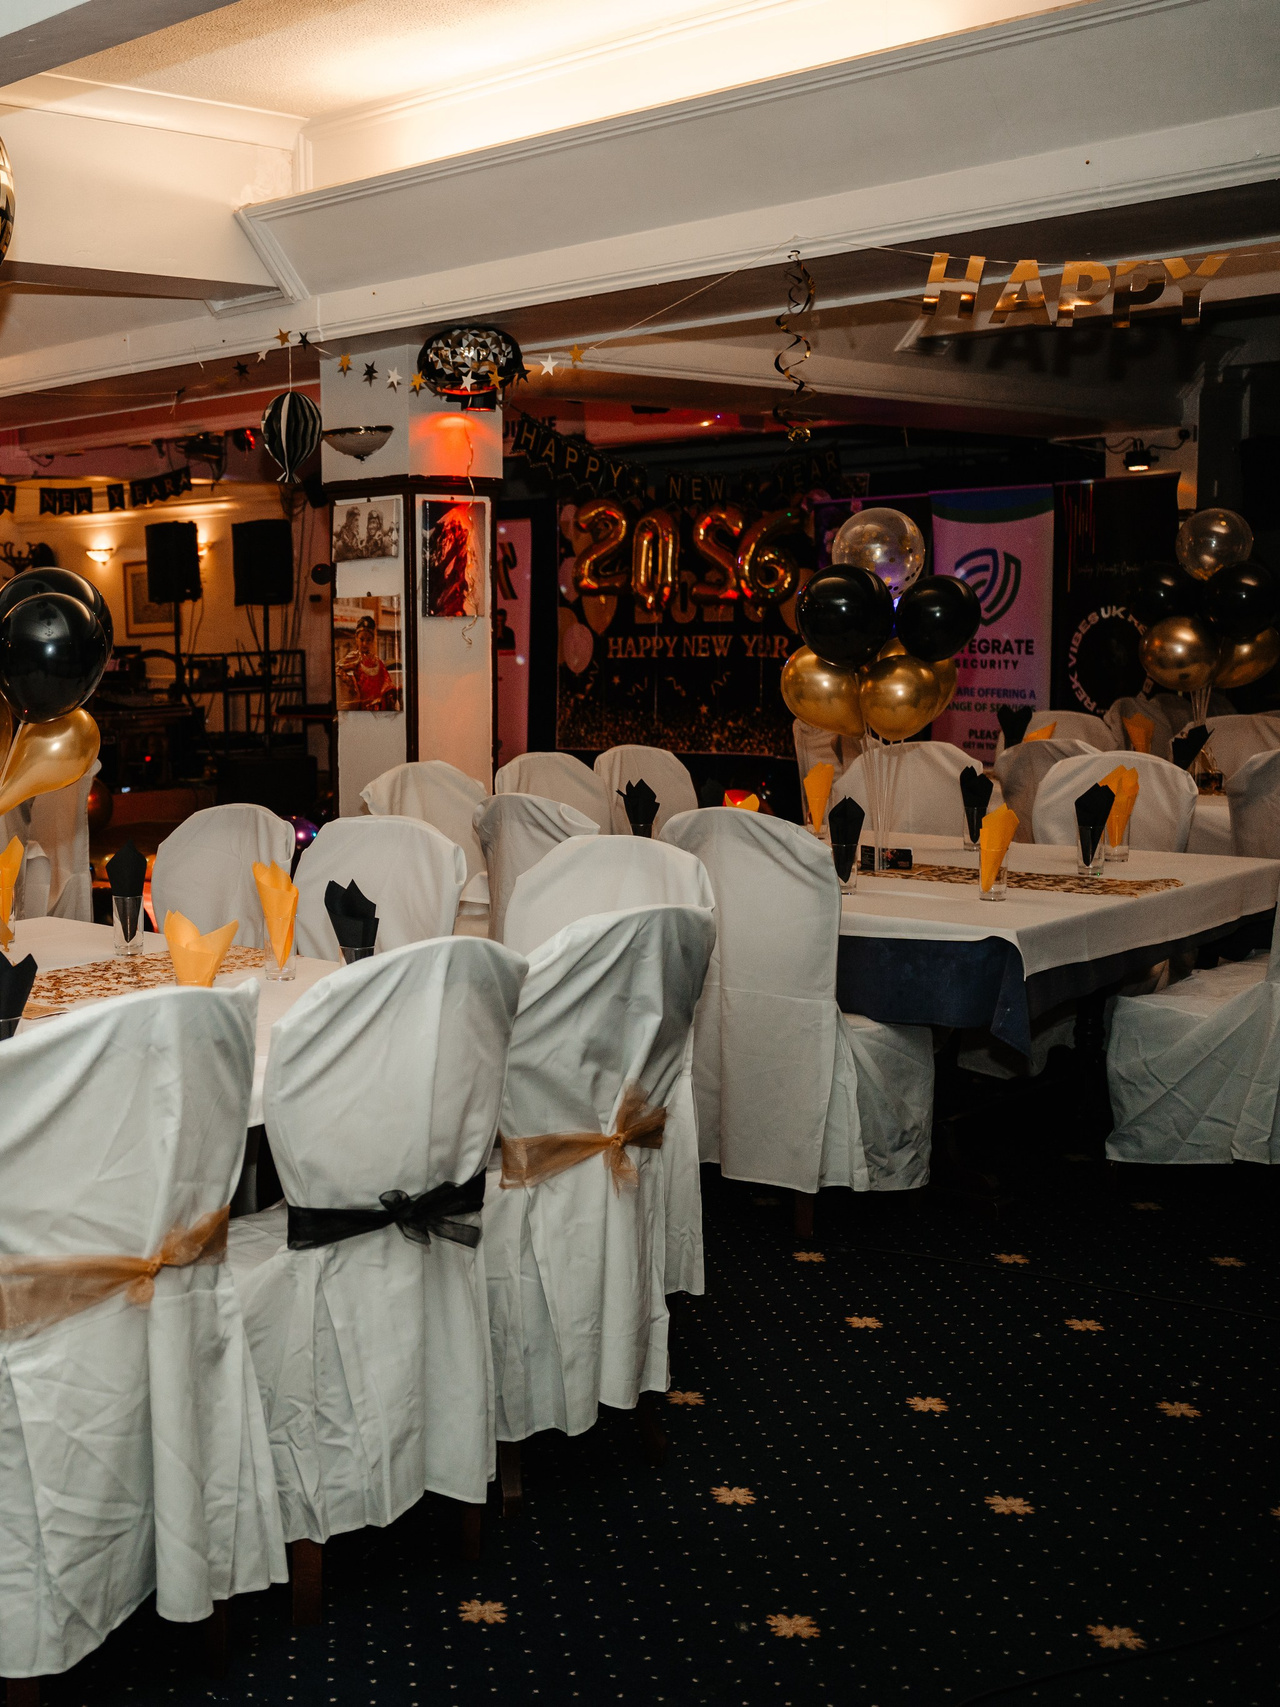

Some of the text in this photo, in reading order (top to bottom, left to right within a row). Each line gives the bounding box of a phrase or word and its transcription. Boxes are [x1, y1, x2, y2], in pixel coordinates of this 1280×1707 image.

[921, 252, 1230, 328] HAPPY
[521, 422, 623, 488] HAPPY
[669, 476, 724, 500] NEW
[777, 451, 838, 492] YEAR
[42, 493, 90, 508] NEW
[1068, 611, 1100, 668] VIBES
[1100, 605, 1128, 620] UK
[607, 634, 679, 659] HAPPY
[683, 634, 734, 658] NEW
[954, 659, 1019, 670] SECURITY
[977, 688, 1027, 700] OFFERING
[946, 701, 972, 711] ANGE
[974, 702, 988, 712] OF
[968, 729, 999, 739] PLEAS
